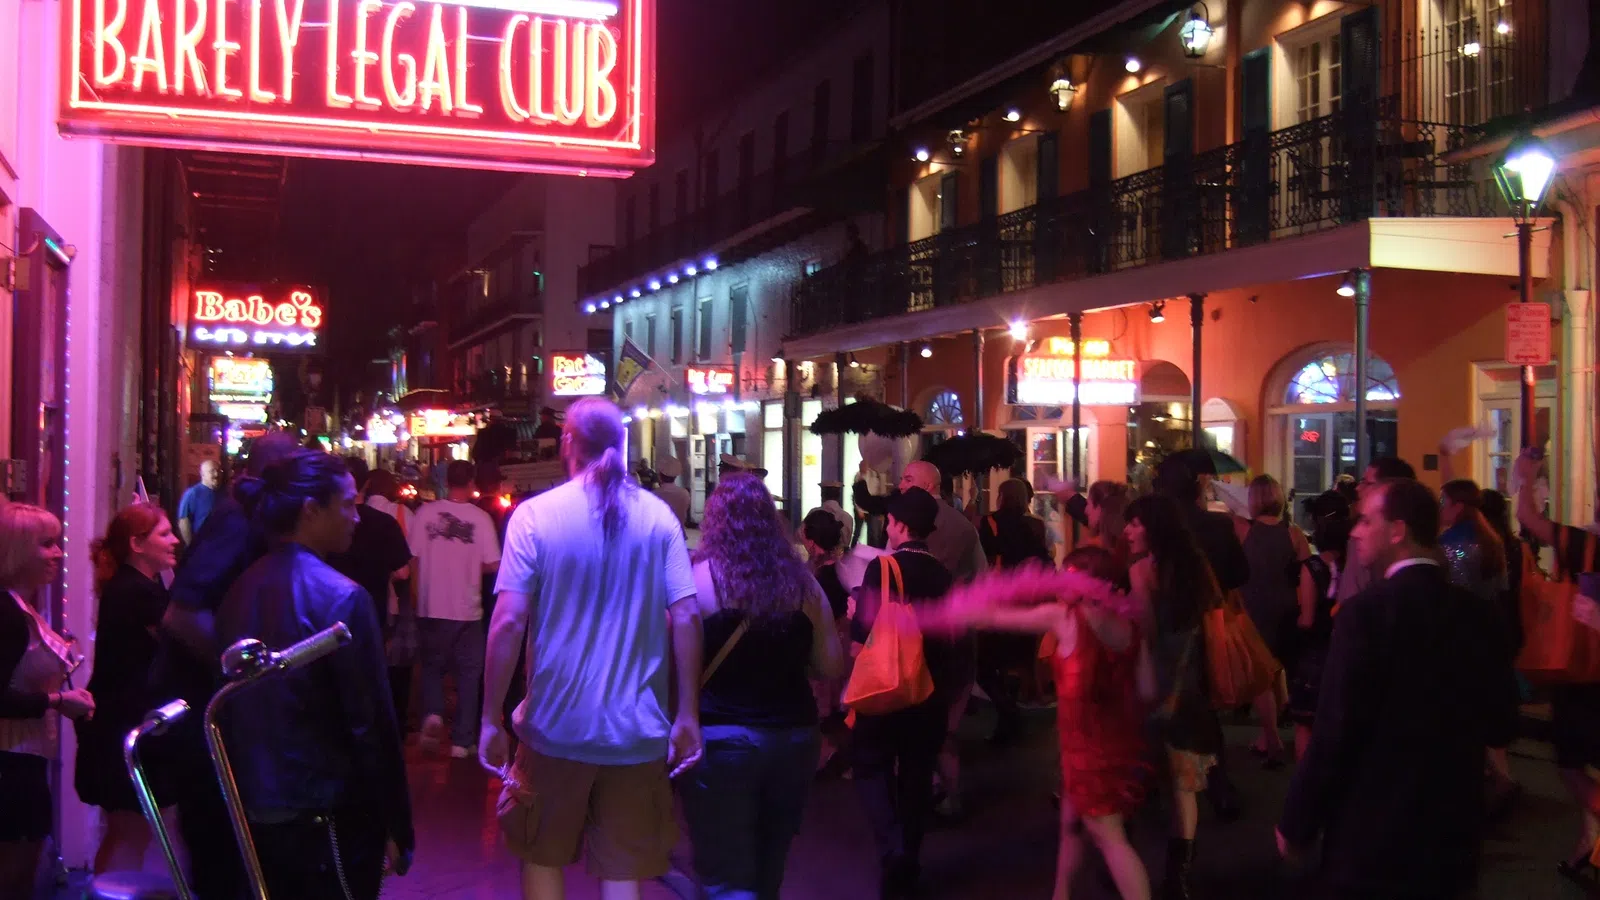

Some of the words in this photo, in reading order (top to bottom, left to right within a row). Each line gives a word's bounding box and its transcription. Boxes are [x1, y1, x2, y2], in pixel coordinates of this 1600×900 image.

[94, 0, 304, 102] BARELY
[326, 0, 483, 118] LEGAL
[499, 14, 618, 127] CLUB
[194, 291, 322, 328] Babe's
[1081, 359, 1135, 380] MARKET
